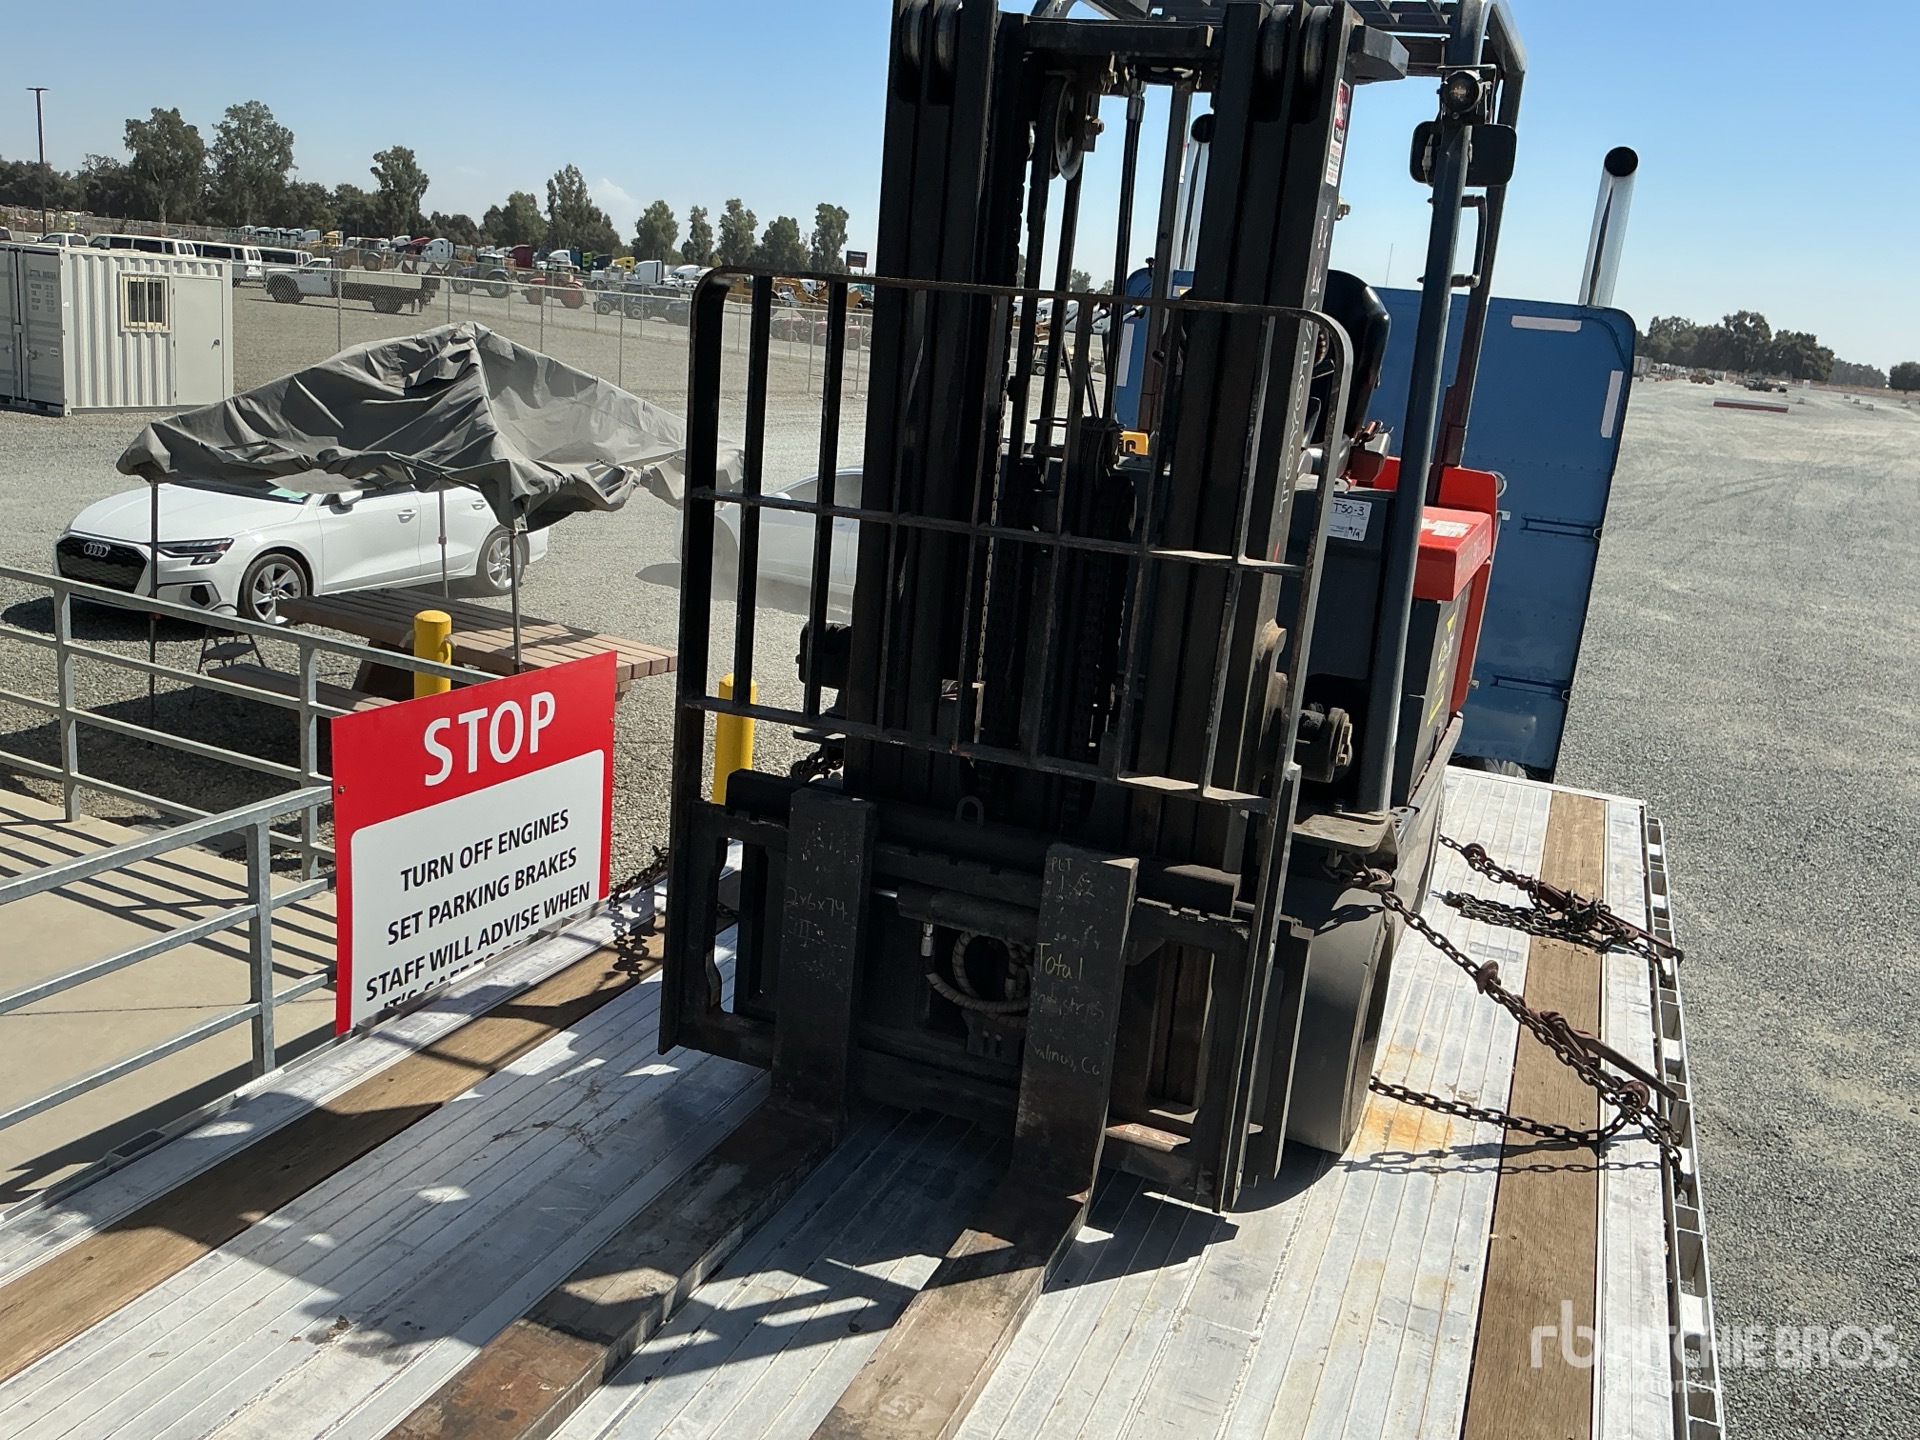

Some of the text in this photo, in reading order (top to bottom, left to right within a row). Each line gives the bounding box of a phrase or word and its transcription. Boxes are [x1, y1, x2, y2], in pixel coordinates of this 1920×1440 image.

[1278, 300, 1318, 514] TOYOTA
[424, 691, 556, 786] STOP
[387, 846, 578, 945] SET PARKING BRAKES
[400, 809, 570, 892] TURN OFF ENGINES
[366, 958, 426, 1002] STAFF
[430, 937, 474, 972] WILL
[477, 903, 540, 951] ADVISE
[543, 881, 591, 919] WHEN
[1036, 942, 1084, 982] Total
